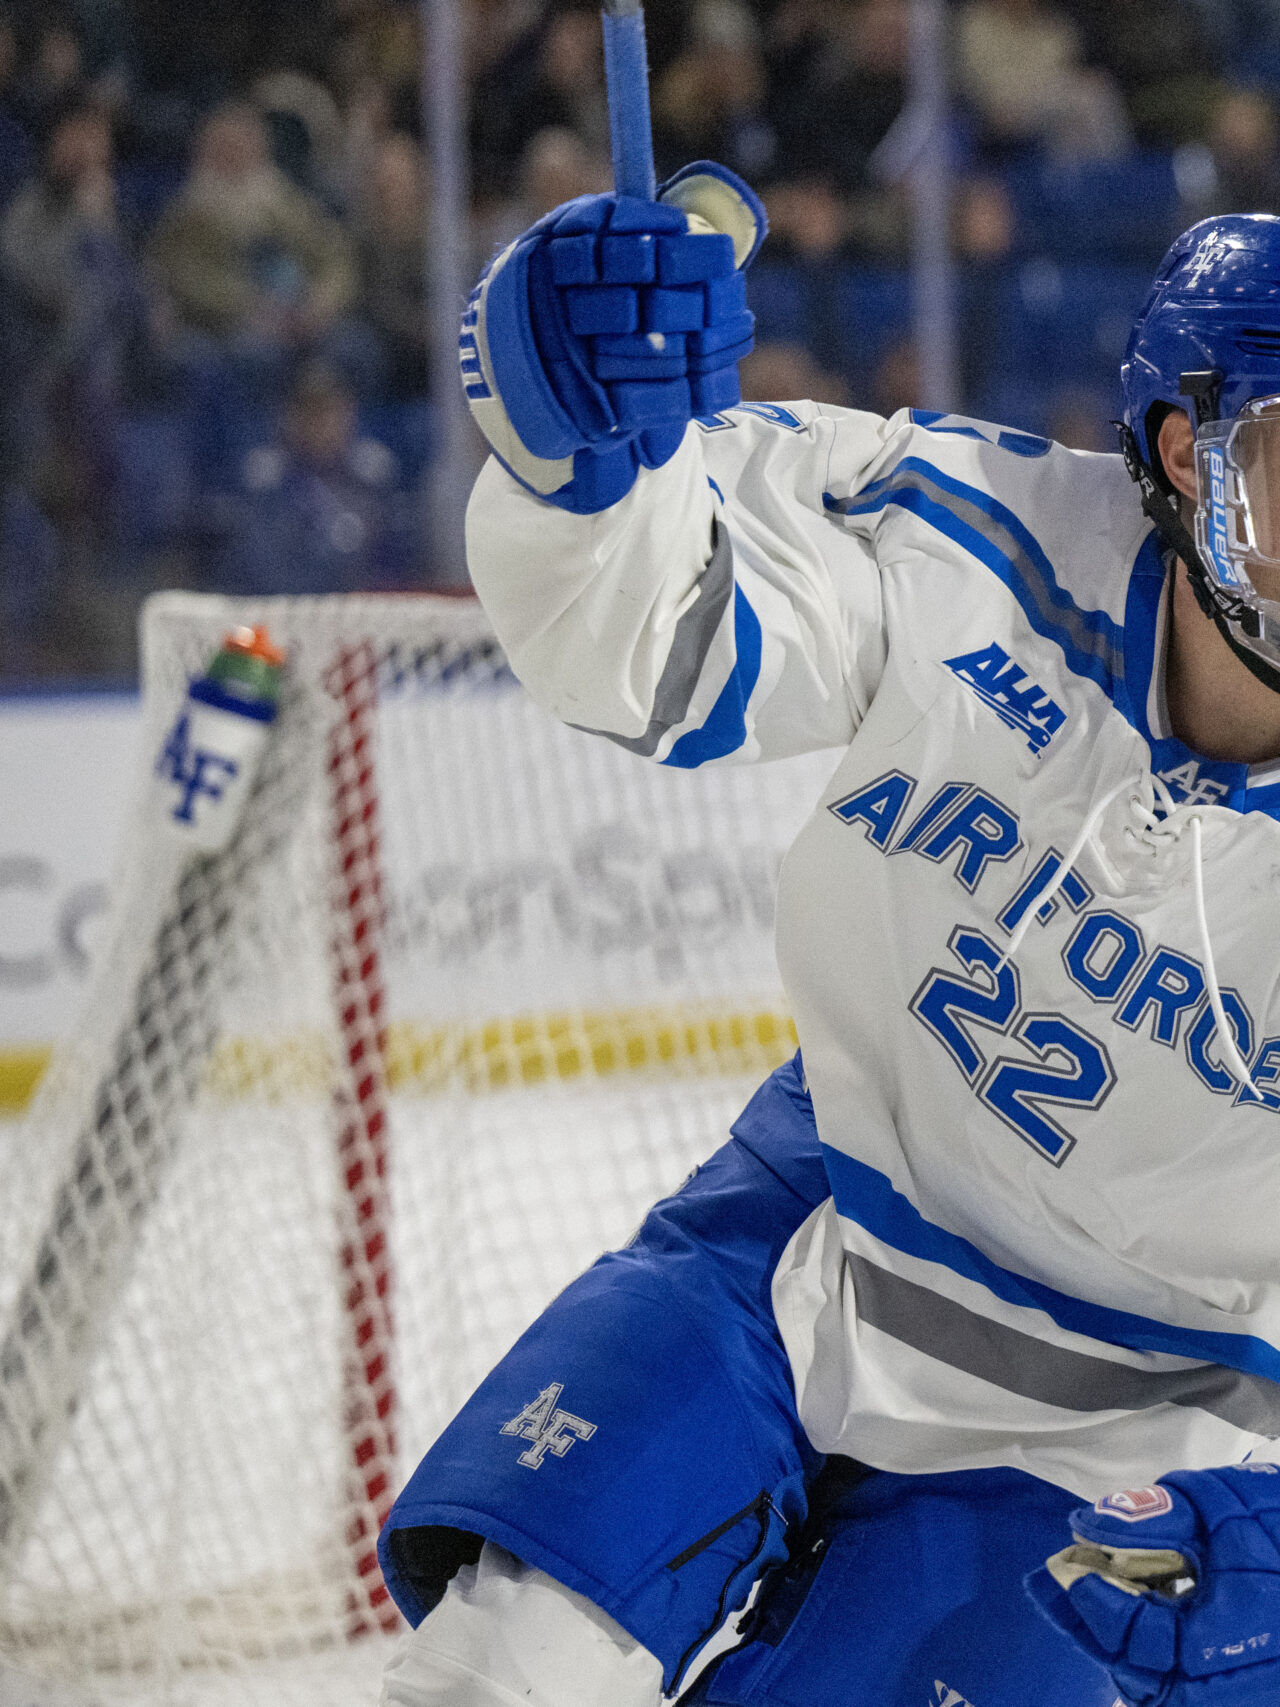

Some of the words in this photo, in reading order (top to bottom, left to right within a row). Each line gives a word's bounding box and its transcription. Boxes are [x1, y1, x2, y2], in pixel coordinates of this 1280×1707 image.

[153, 706, 238, 827] AF
[826, 768, 1025, 895] AIR
[908, 924, 1118, 1168] 22
[499, 1381, 598, 1471] AF
